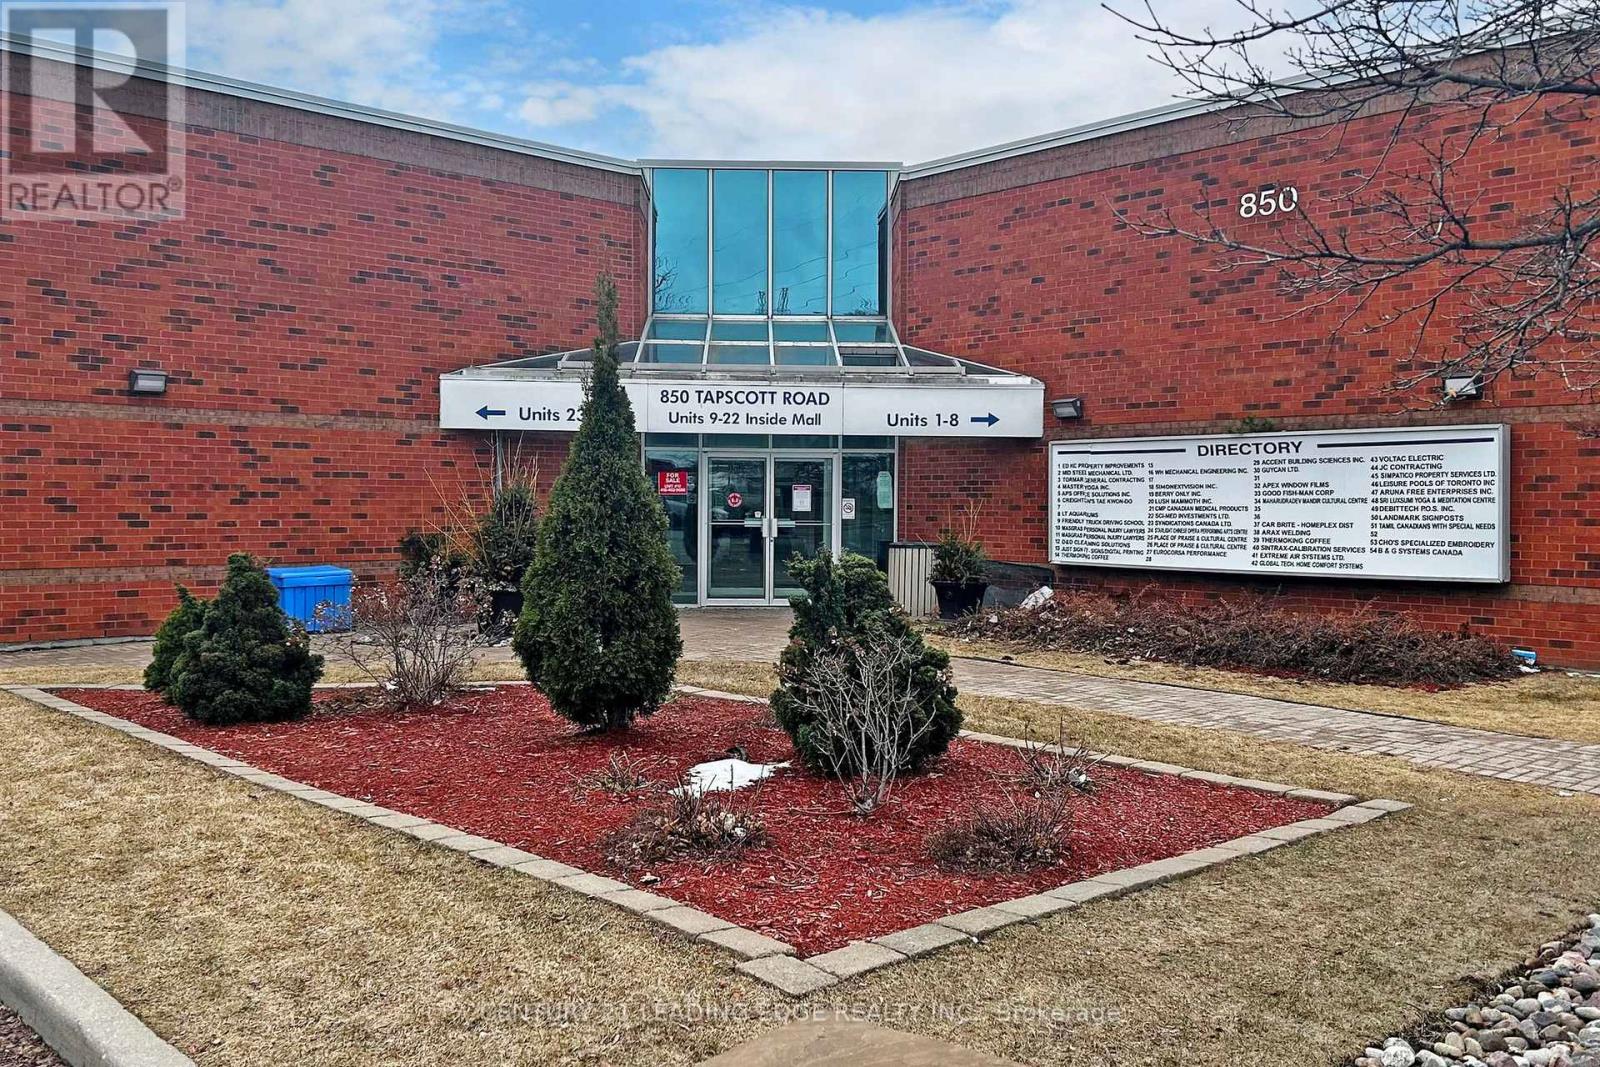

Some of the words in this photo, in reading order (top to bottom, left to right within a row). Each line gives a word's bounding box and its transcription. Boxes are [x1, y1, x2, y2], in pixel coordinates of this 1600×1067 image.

[1240, 186, 1298, 218] 850
[660, 389, 690, 404] 850
[697, 390, 777, 404] TAPSCOTT
[782, 391, 830, 406] ROAD
[519, 406, 560, 422] Units
[668, 411, 705, 424] Units
[709, 412, 740, 425] 9-22
[745, 412, 787, 426] Inside
[791, 412, 821, 426] Mall
[886, 413, 928, 427] Units
[936, 414, 959, 427] 1-8
[1197, 441, 1303, 457] DIRECTORY
